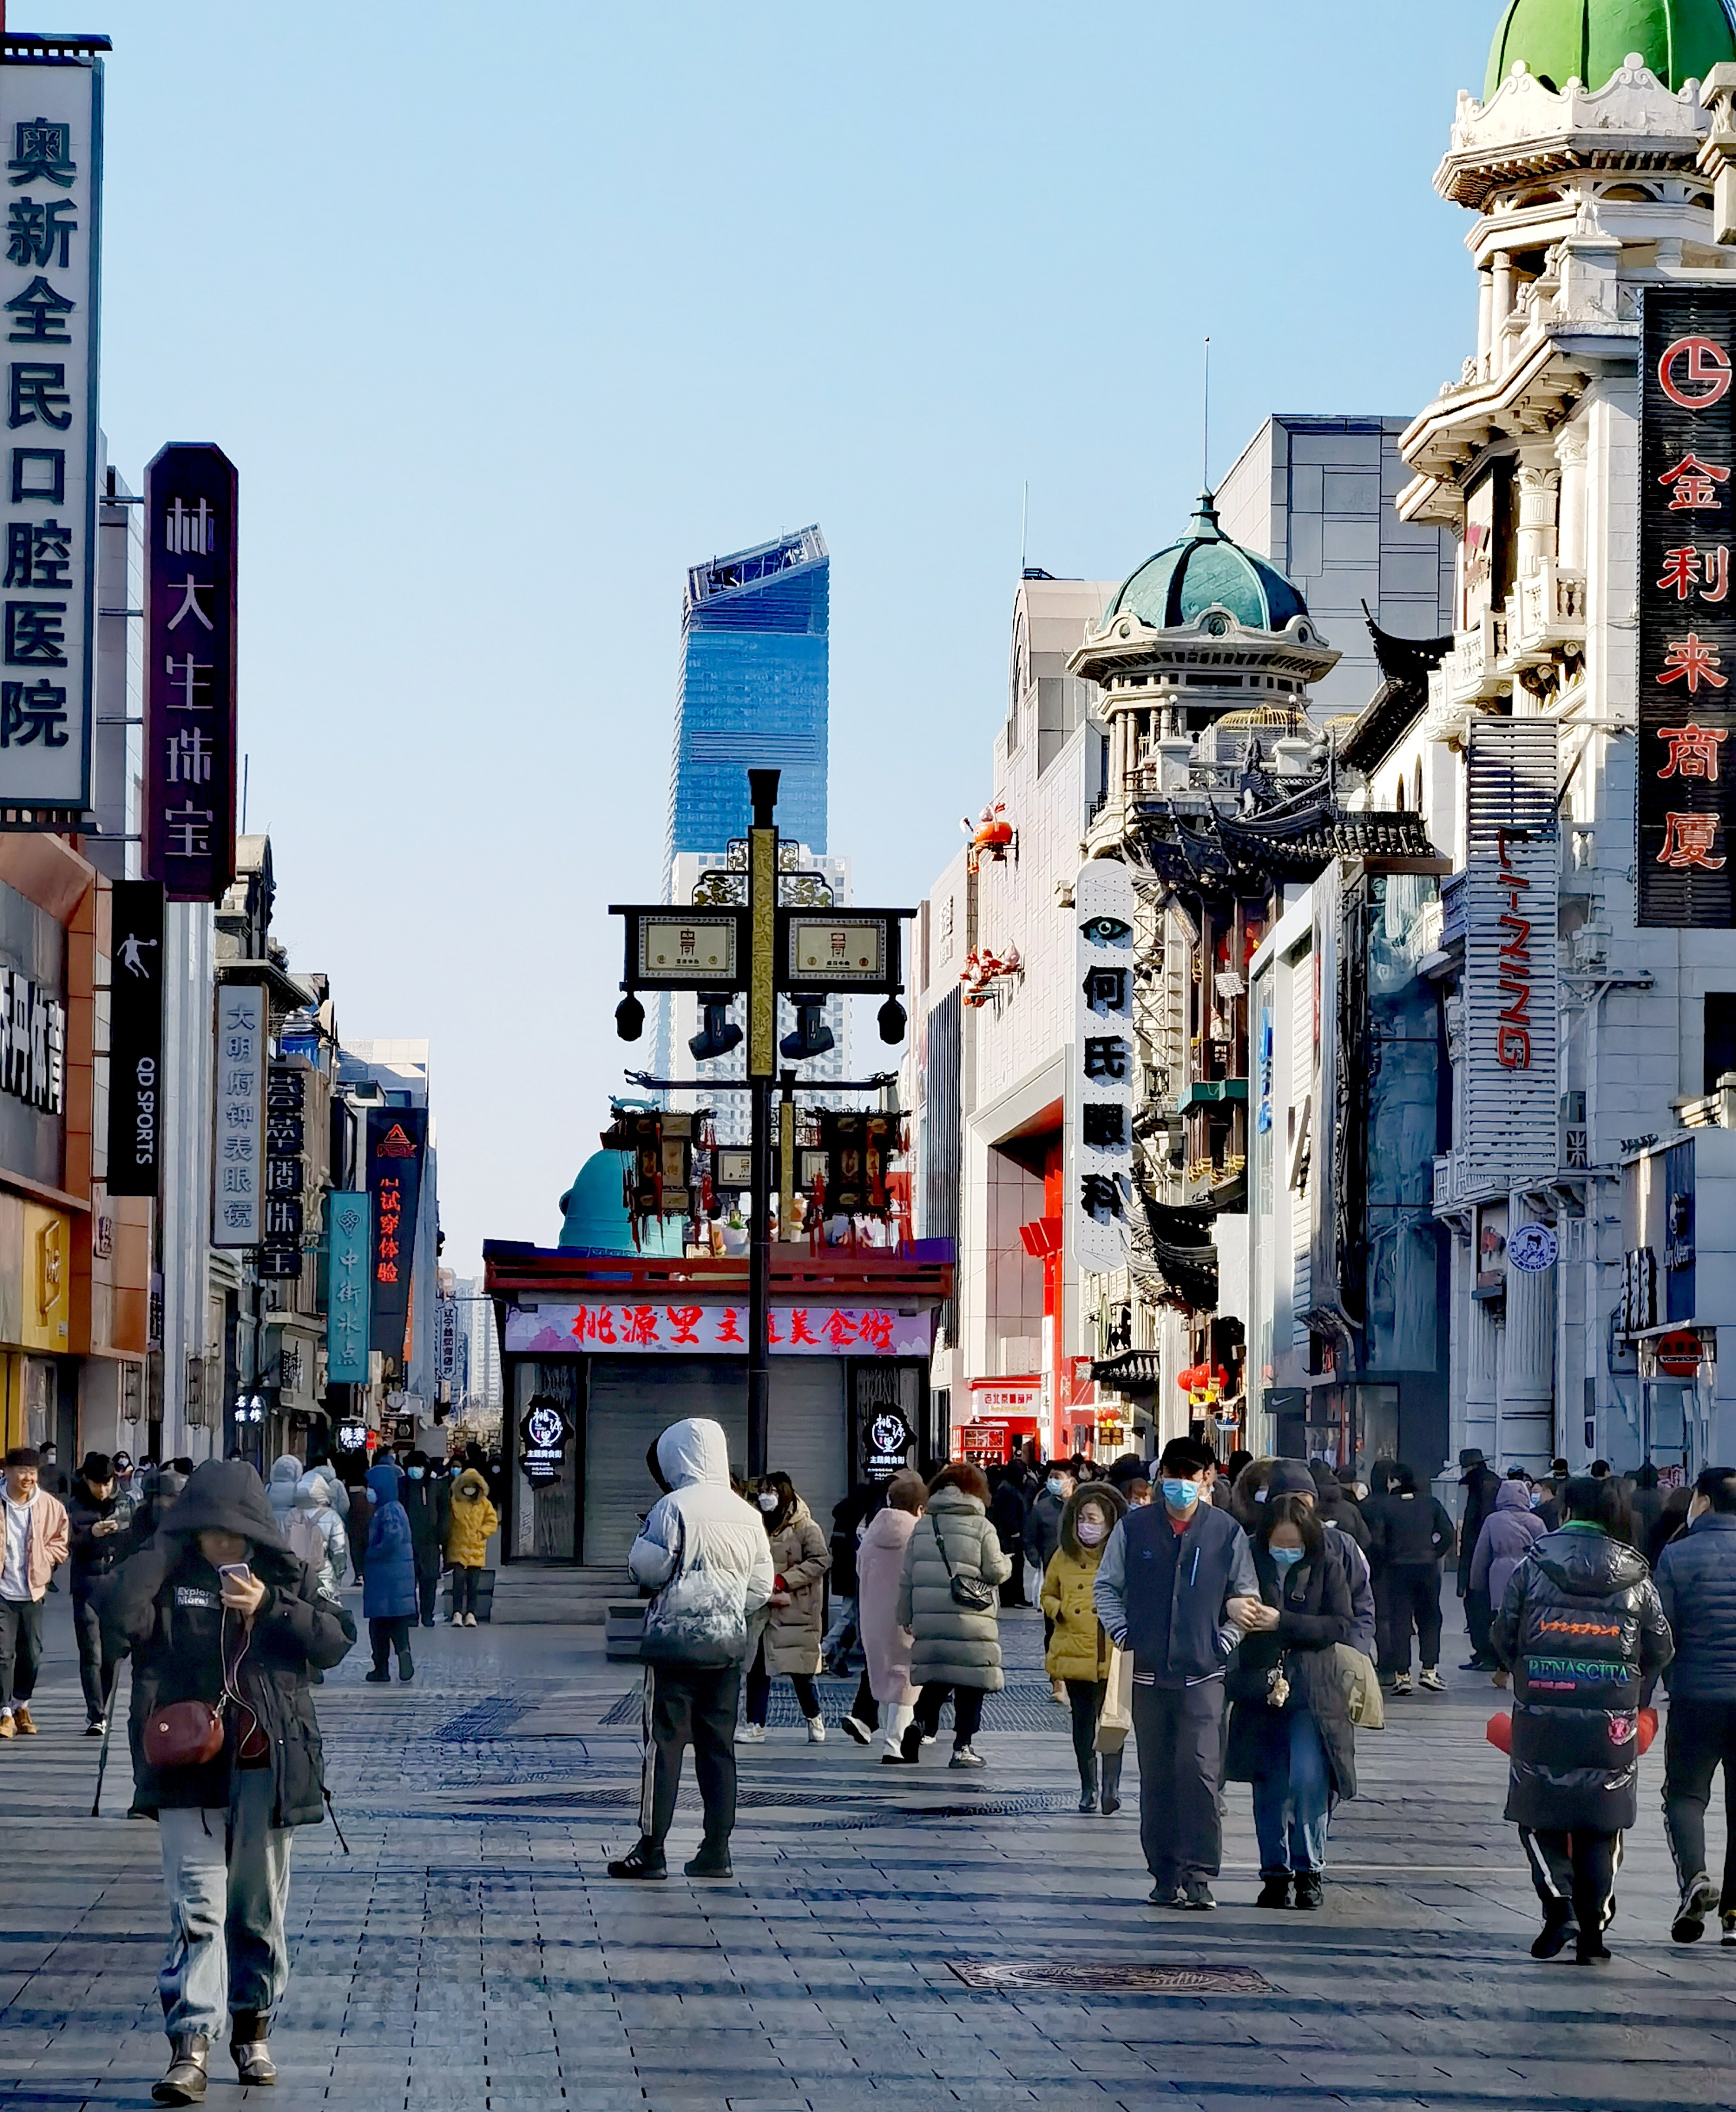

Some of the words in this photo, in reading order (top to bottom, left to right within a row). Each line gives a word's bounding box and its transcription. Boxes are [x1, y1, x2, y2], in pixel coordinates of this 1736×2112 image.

[1, 117, 77, 748] 奥新全民口腔医院
[165, 497, 214, 858] 林大生珠宝
[1657, 453, 1731, 869] 金利来商厦
[1498, 827, 1531, 1069] LI-NING
[135, 1091, 154, 1165] SPORTS
[136, 1056, 155, 1087] QD
[340, 1427, 366, 1442] 修表
